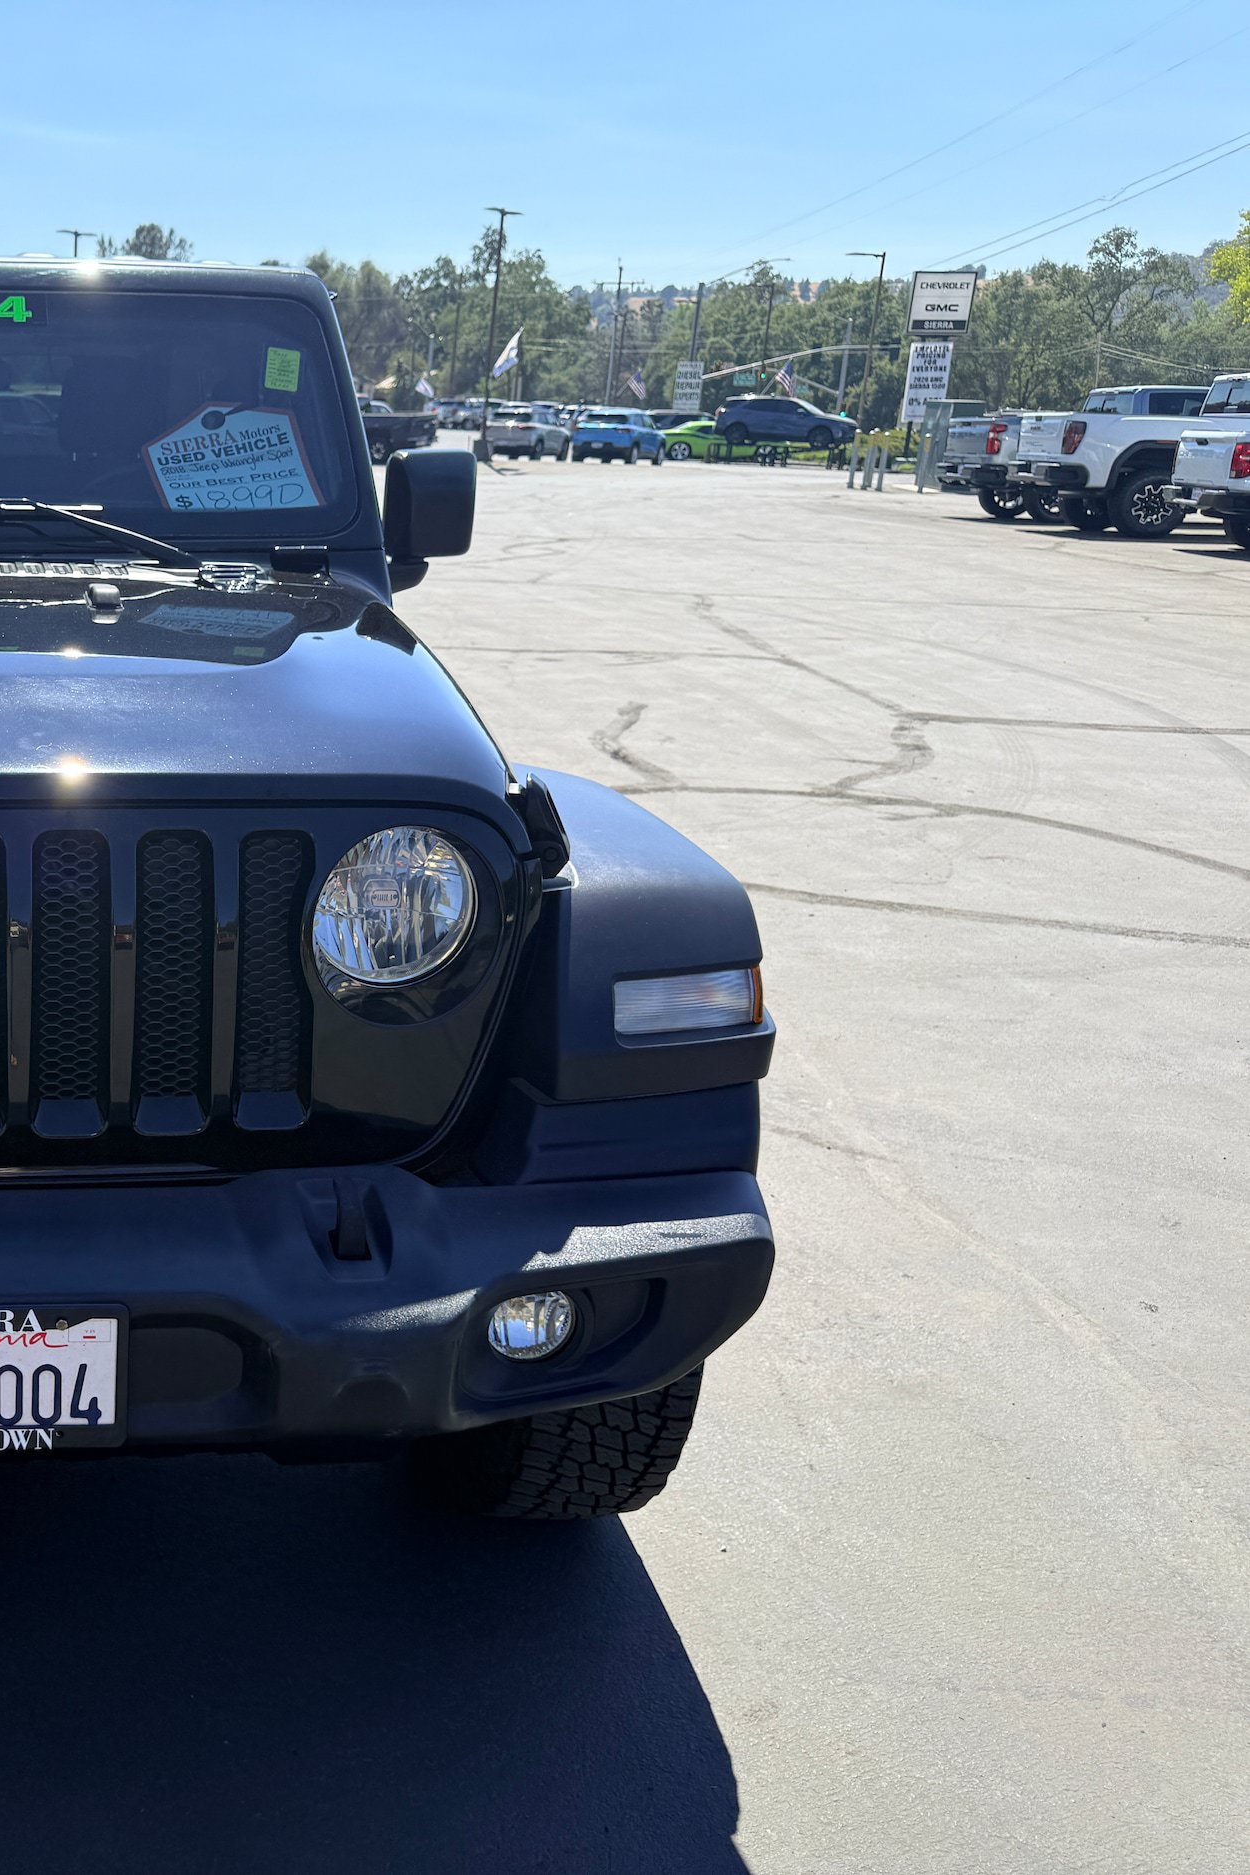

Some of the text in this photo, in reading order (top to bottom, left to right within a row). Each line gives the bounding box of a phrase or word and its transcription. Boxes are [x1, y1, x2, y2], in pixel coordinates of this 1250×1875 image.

[920, 282, 971, 290] CHEVROLET
[925, 304, 959, 312] GMC
[923, 321, 954, 329] SIERRA
[160, 423, 281, 457] SIERRA Motors
[157, 432, 290, 467] USED VEHICLE
[190, 462, 220, 474] Jeep
